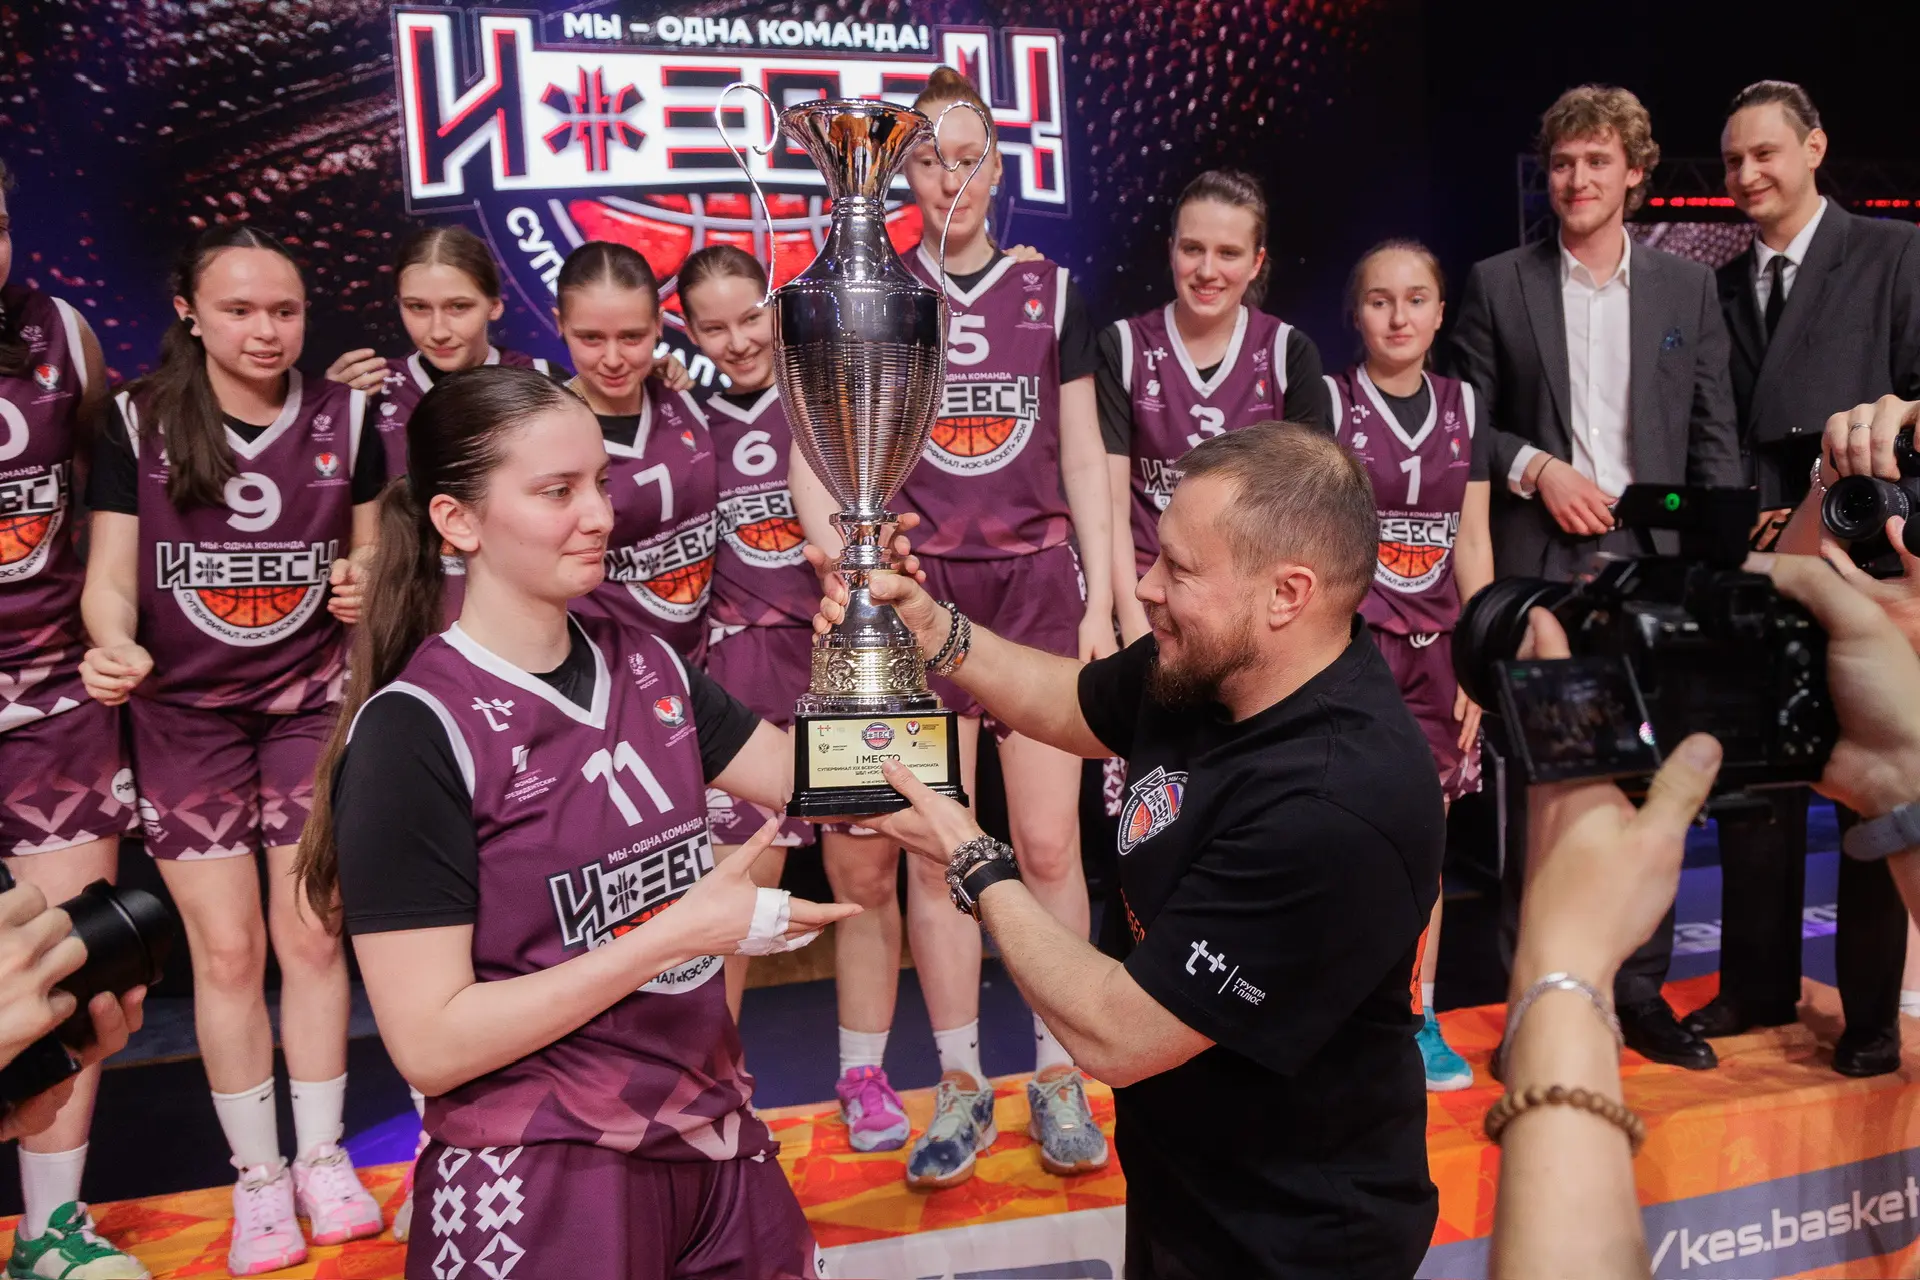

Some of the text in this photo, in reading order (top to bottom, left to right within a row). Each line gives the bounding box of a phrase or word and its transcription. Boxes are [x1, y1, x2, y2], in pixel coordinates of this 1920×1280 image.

[563, 12, 621, 40] МЫ
[657, 15, 753, 46] ОДНА
[759, 18, 930, 52] КОМАНДА!
[947, 315, 990, 365] 5
[968, 371, 1012, 381] КОМАНДА
[1187, 403, 1227, 449] 3
[732, 430, 777, 476] 6
[224, 472, 282, 532] 9
[632, 462, 674, 522] 7
[1400, 455, 1421, 505] 1
[255, 540, 306, 550] КОМАНДА
[581, 740, 675, 827] 11
[662, 817, 704, 842] КОМАНДА
[1232, 984, 1262, 1006] Т ПЛЮС
[1235, 977, 1266, 1000] ГРУППА
